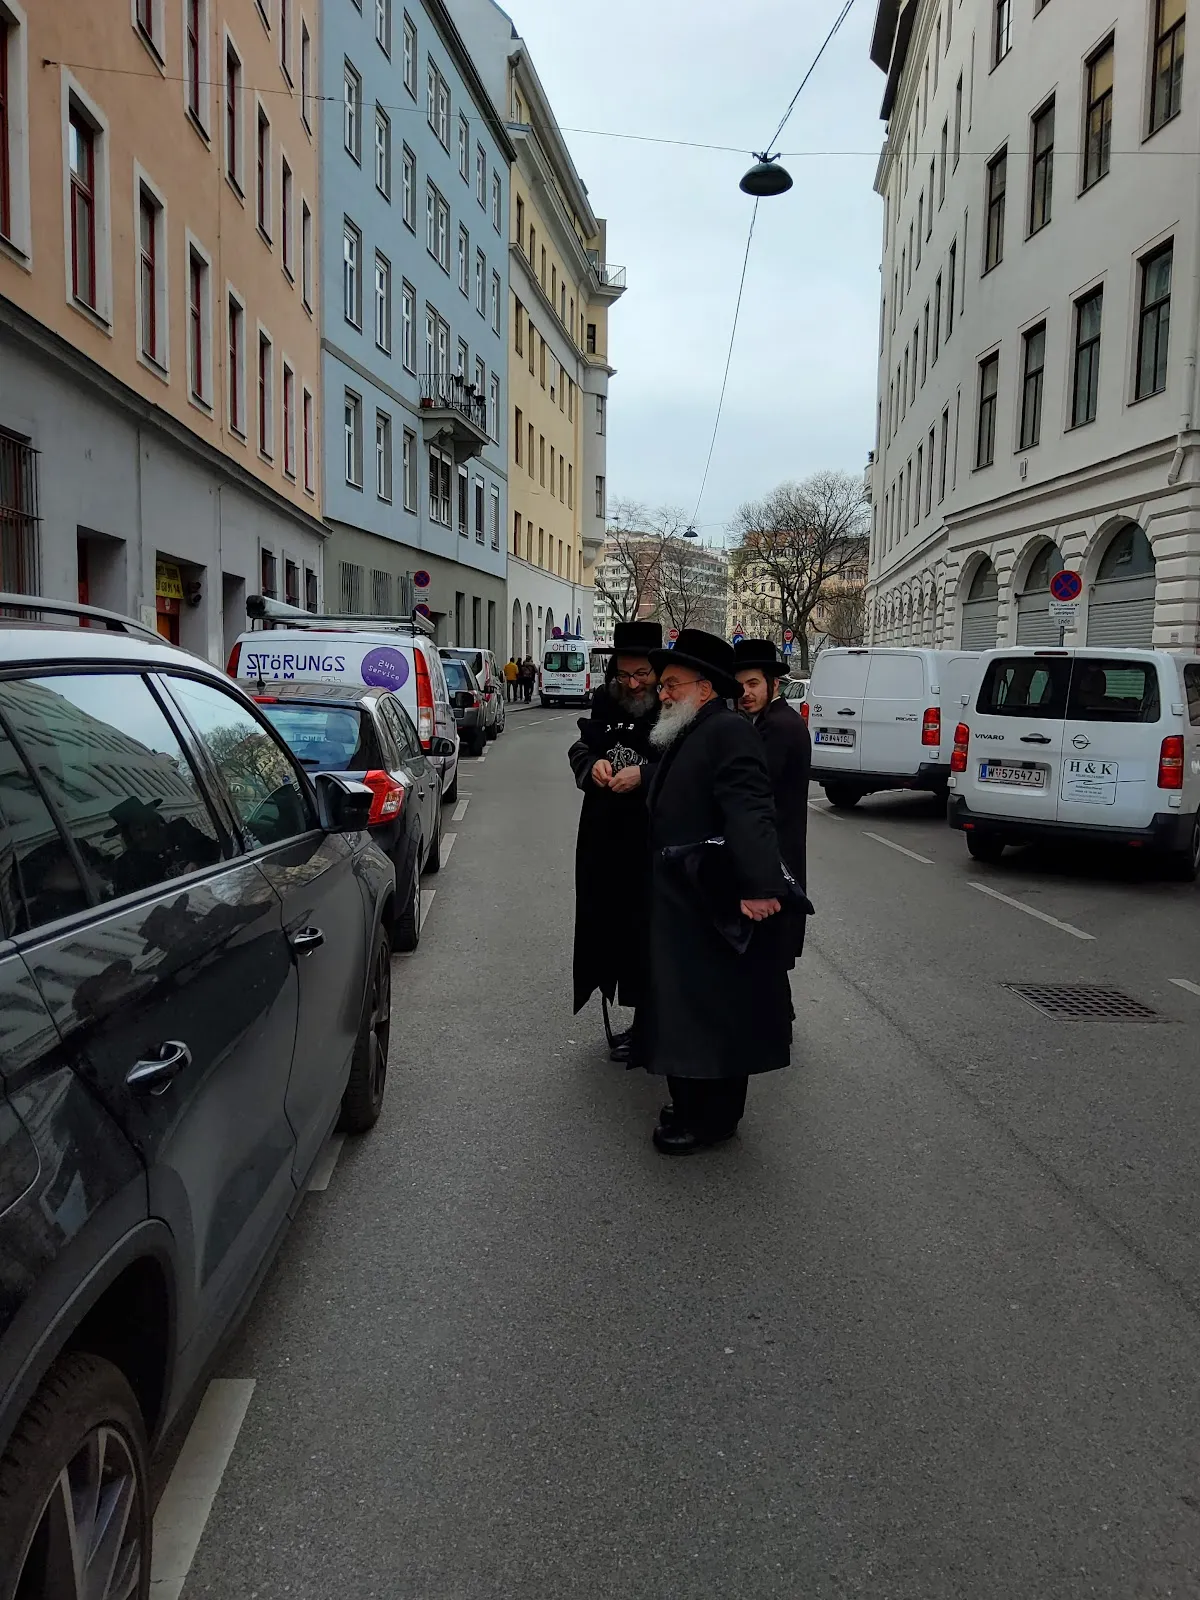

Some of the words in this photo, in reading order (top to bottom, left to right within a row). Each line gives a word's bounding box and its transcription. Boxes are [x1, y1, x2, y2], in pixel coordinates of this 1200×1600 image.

[378, 659, 395, 671] 24h
[368, 665, 400, 680] Service
[974, 733, 1005, 741] VIVARO
[1069, 761, 1081, 773] H
[1084, 762, 1097, 774] &
[1101, 763, 1113, 776] K
